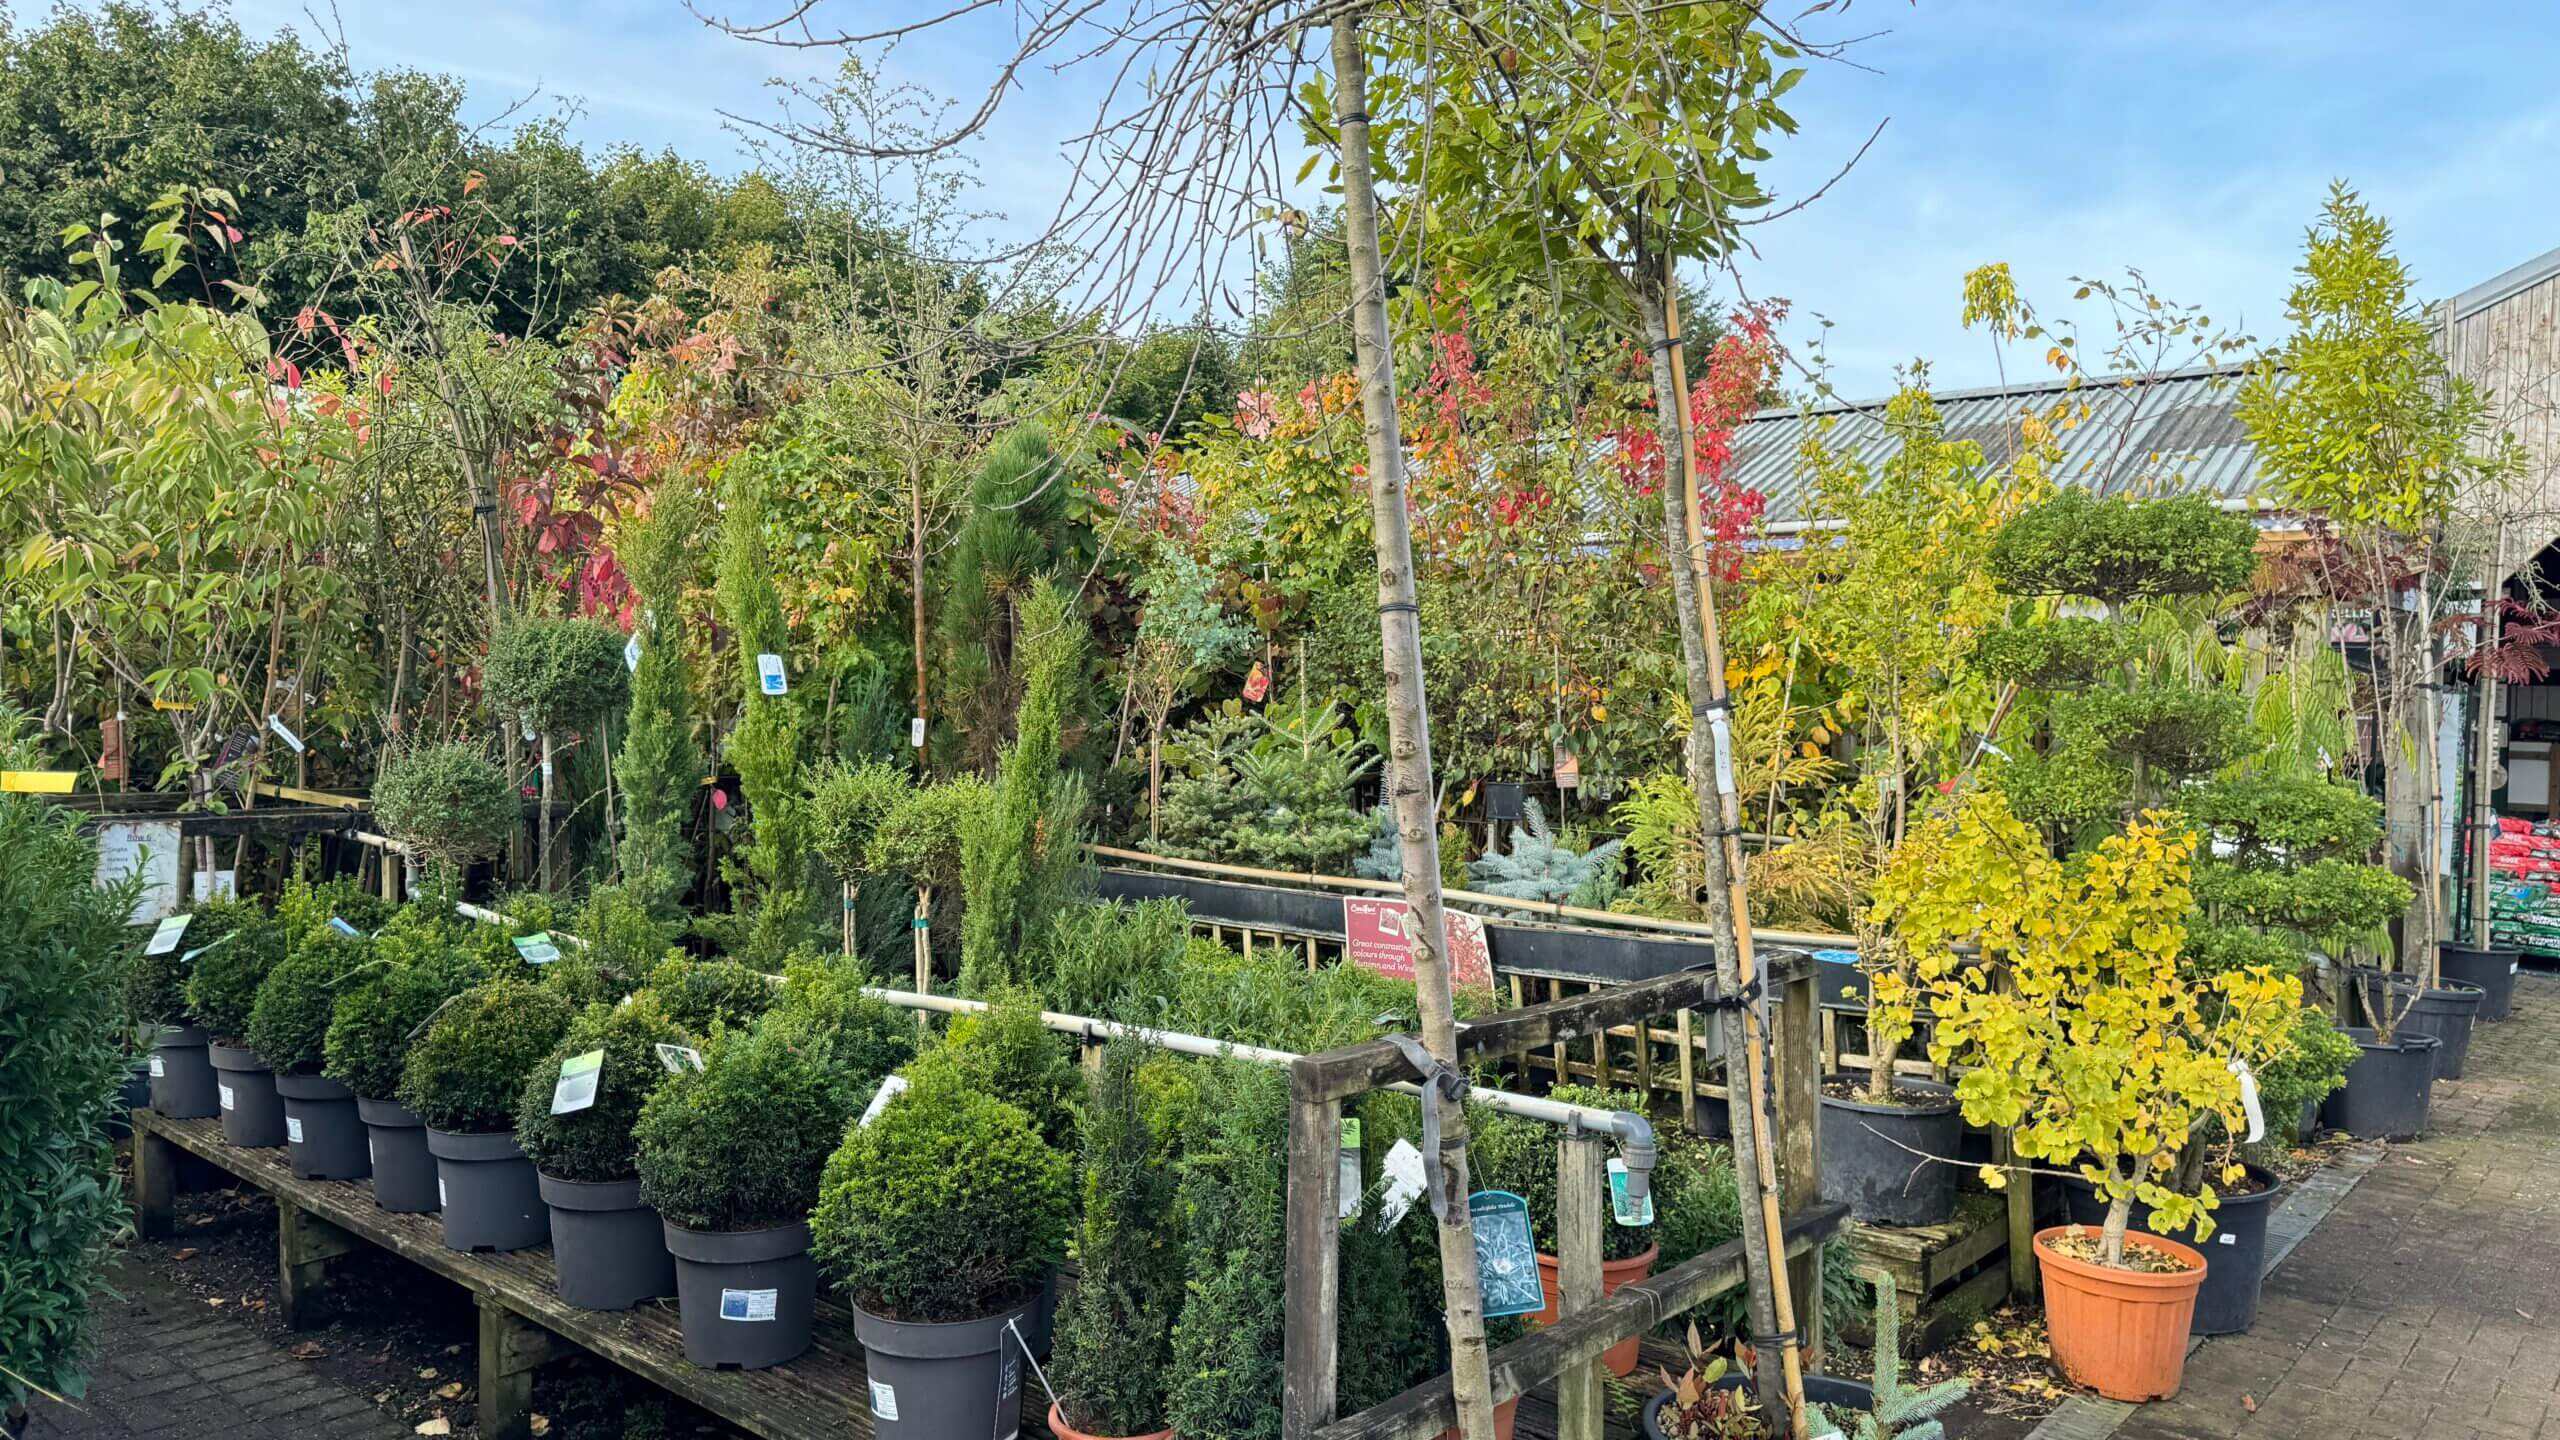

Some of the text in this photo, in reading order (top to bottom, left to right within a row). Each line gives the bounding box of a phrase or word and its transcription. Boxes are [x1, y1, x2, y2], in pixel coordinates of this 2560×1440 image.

[1352, 938, 1412, 953] Great contrasting
[1352, 949, 1405, 963] colours through
[1381, 961, 1396, 970] and
[1397, 962, 1415, 972] Win
